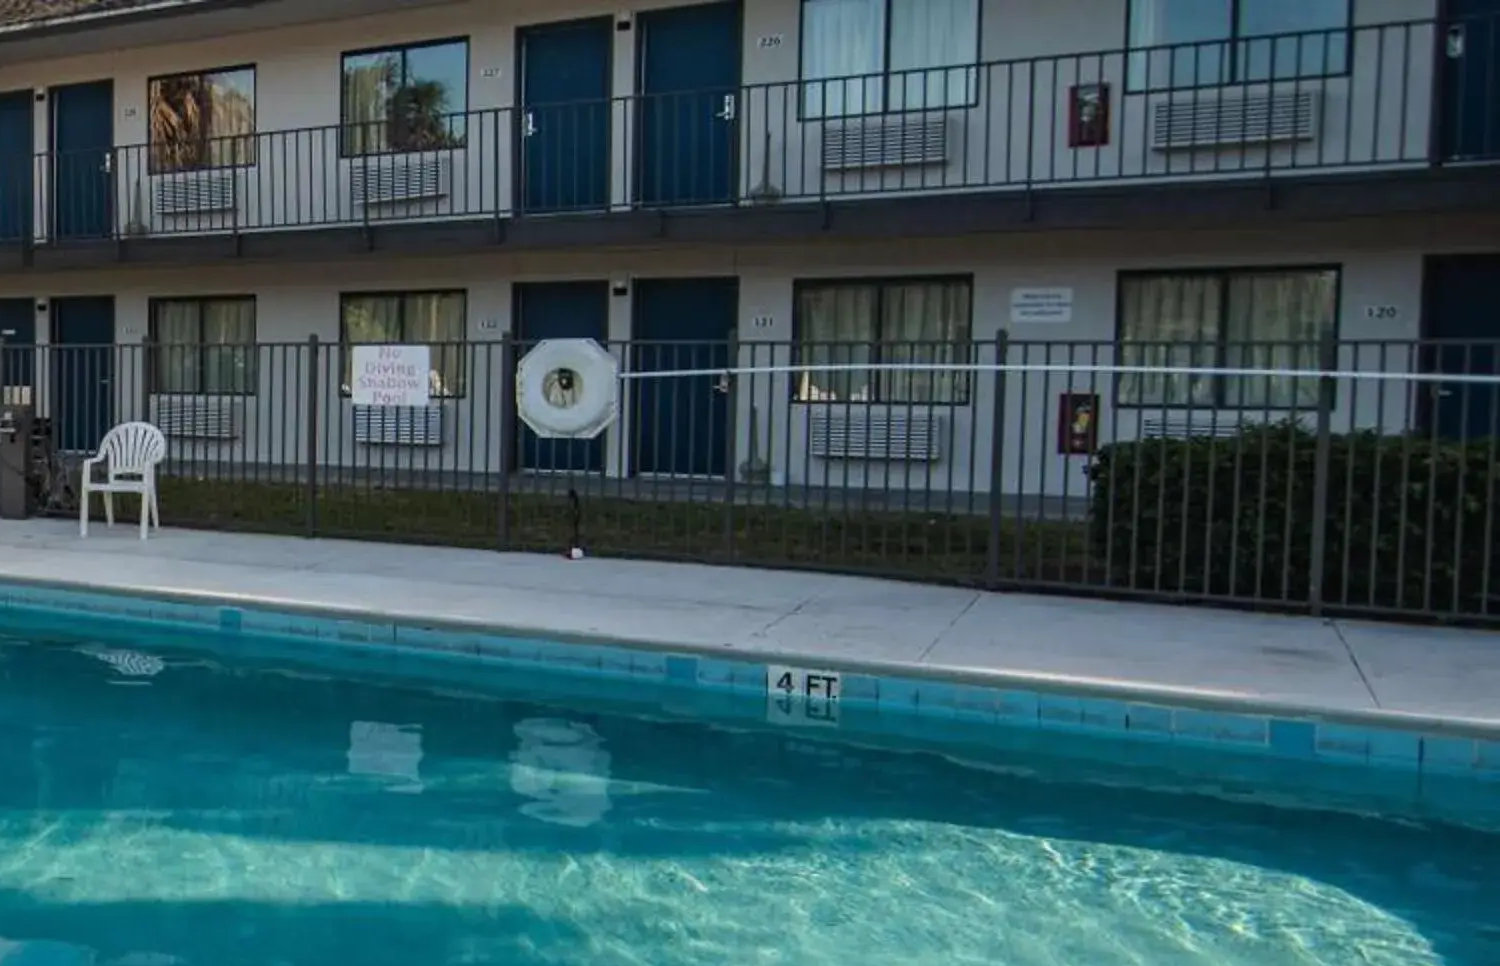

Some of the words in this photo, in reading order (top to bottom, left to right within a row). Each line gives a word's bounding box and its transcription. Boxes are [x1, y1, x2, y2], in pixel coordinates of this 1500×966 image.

[1367, 306, 1397, 319] 120
[379, 347, 401, 359] No
[776, 671, 794, 694] 4
